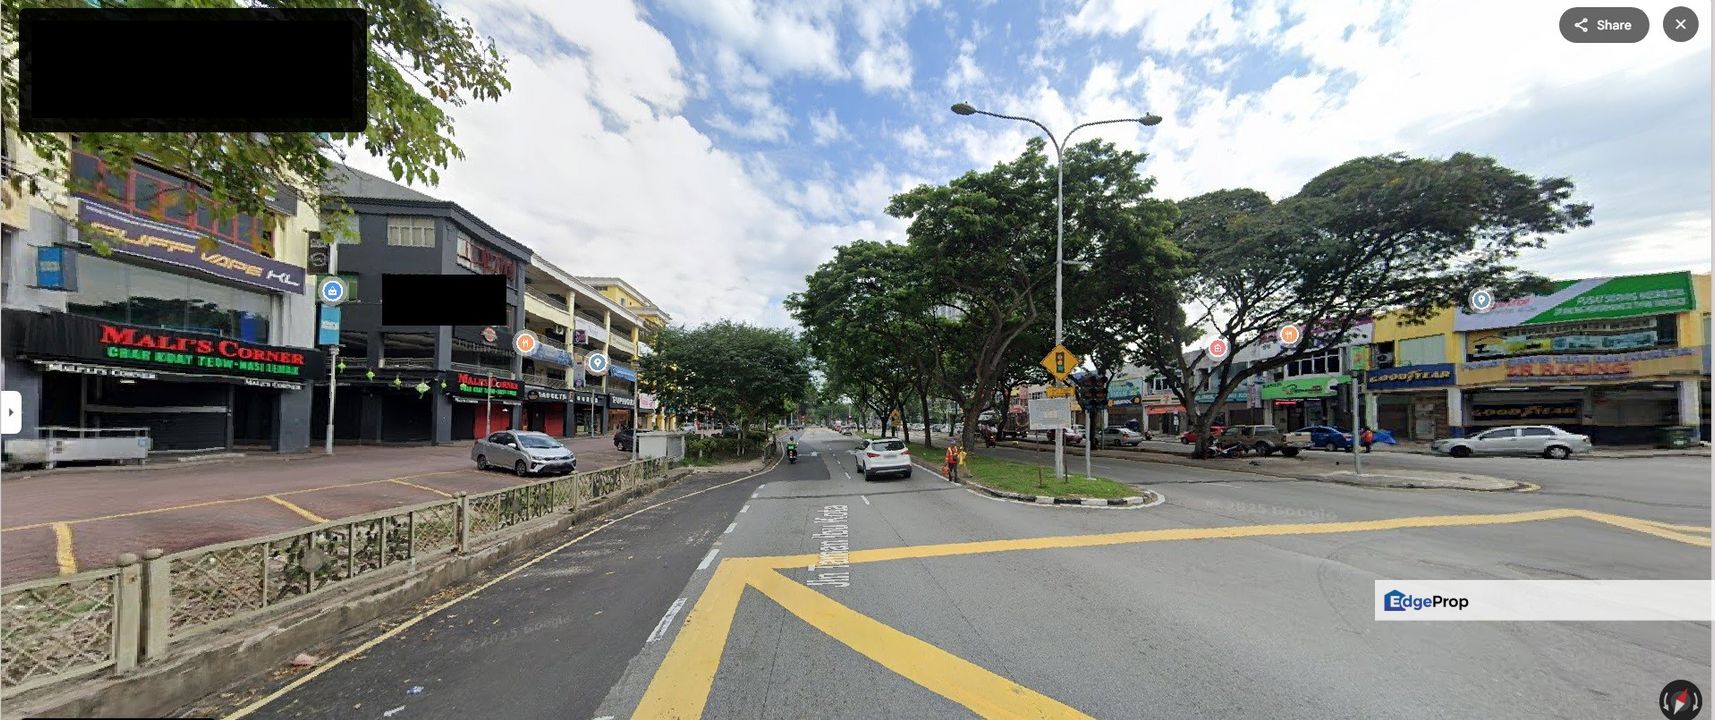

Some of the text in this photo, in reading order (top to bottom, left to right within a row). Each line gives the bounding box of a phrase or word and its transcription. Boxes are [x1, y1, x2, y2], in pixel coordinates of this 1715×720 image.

[201, 253, 264, 277] VAPE
[266, 270, 299, 287] KL
[100, 325, 305, 365] MALI'S CORNER
[1369, 367, 1450, 383] GOODYEAR
